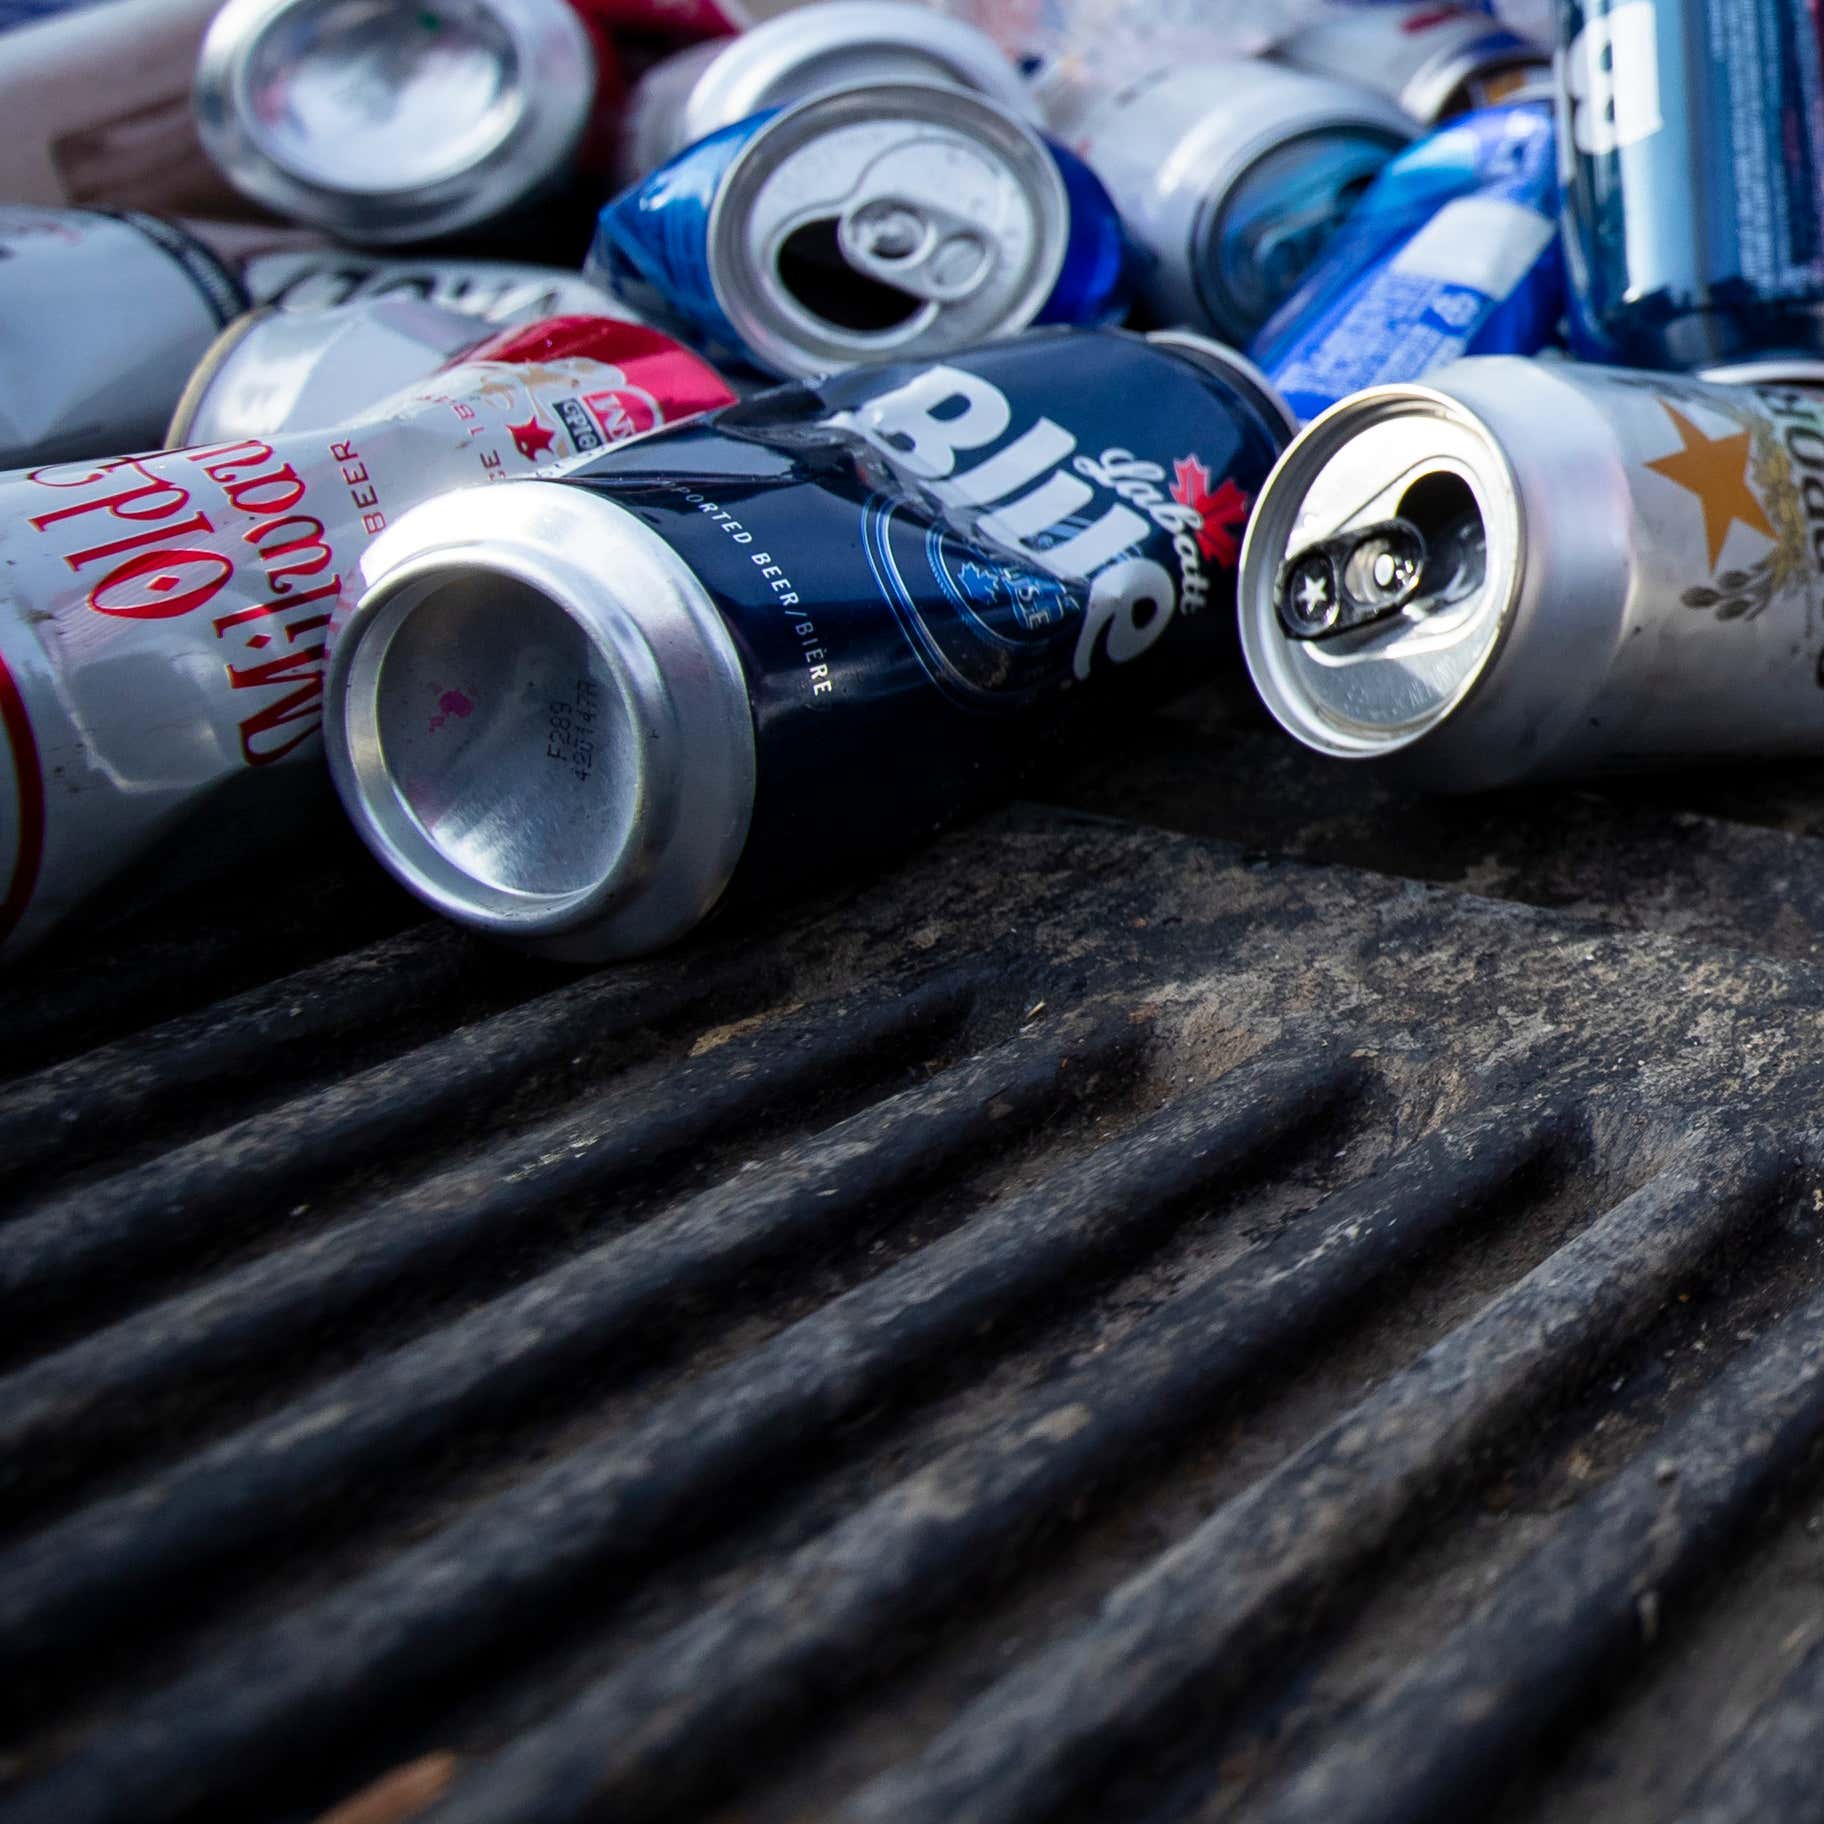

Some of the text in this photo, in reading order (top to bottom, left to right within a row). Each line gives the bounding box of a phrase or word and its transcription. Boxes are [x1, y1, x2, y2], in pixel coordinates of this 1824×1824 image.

[330, 439, 387, 536] BEER
[824, 364, 1176, 681] Blue
[1073, 447, 1213, 616] Labatt
